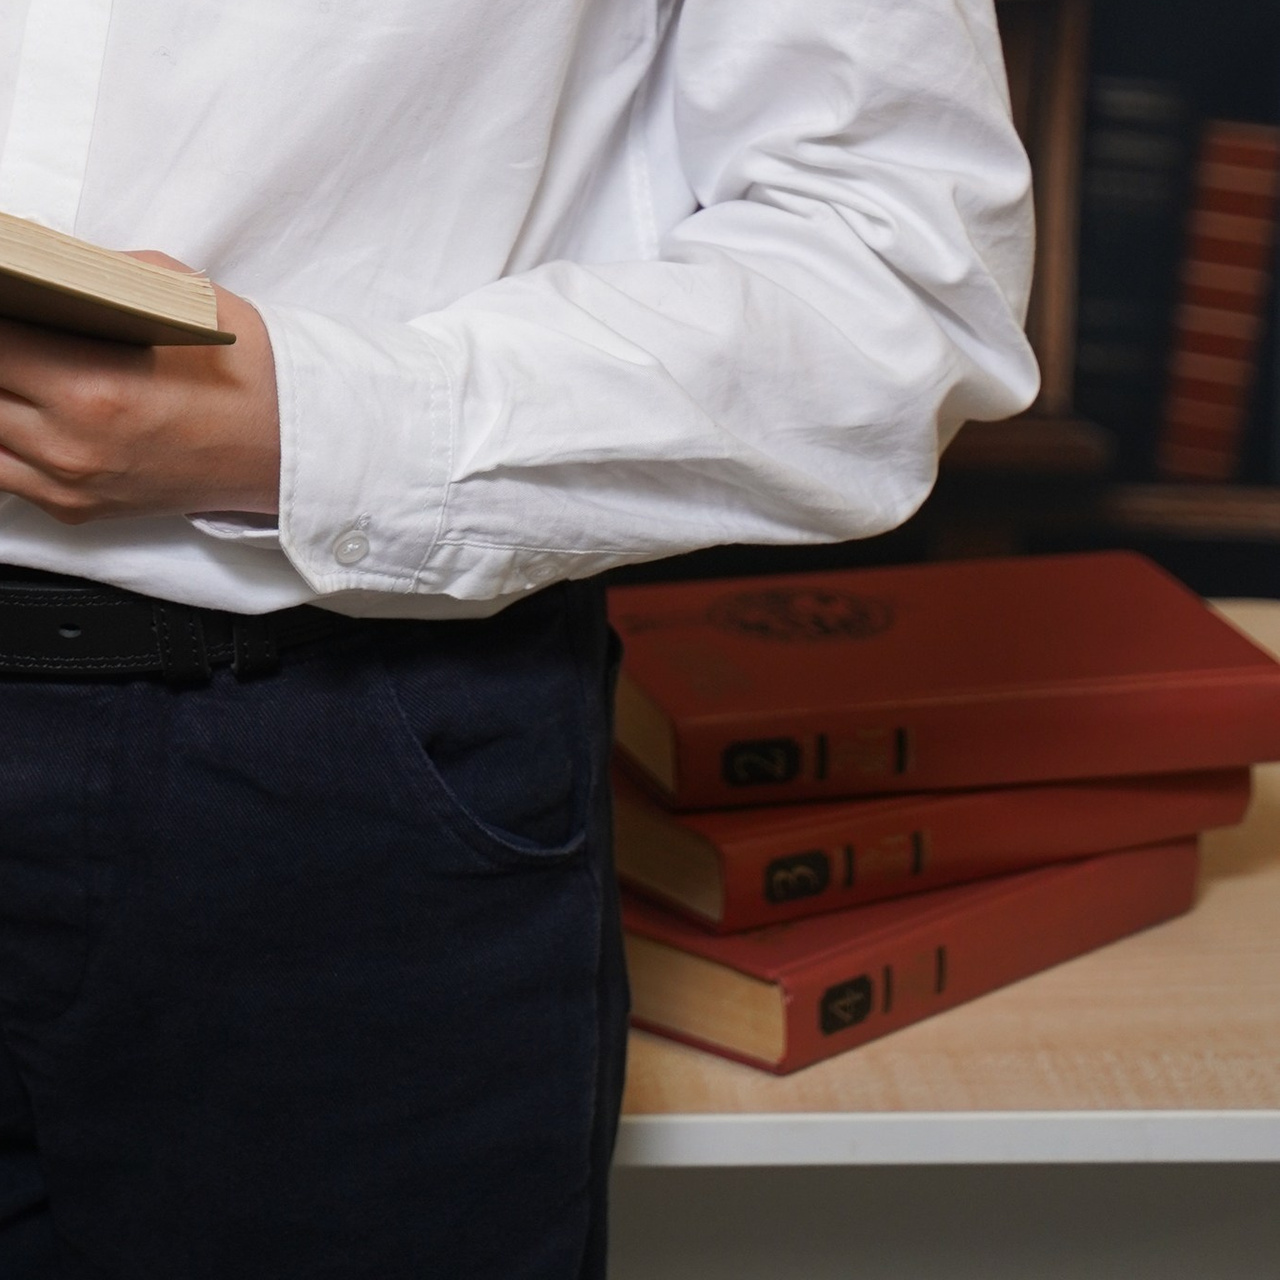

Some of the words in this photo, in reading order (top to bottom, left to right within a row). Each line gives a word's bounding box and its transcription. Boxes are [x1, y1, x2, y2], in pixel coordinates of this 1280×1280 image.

[732, 749, 784, 780] 2
[771, 865, 819, 897] 3
[828, 990, 865, 1025] 4
